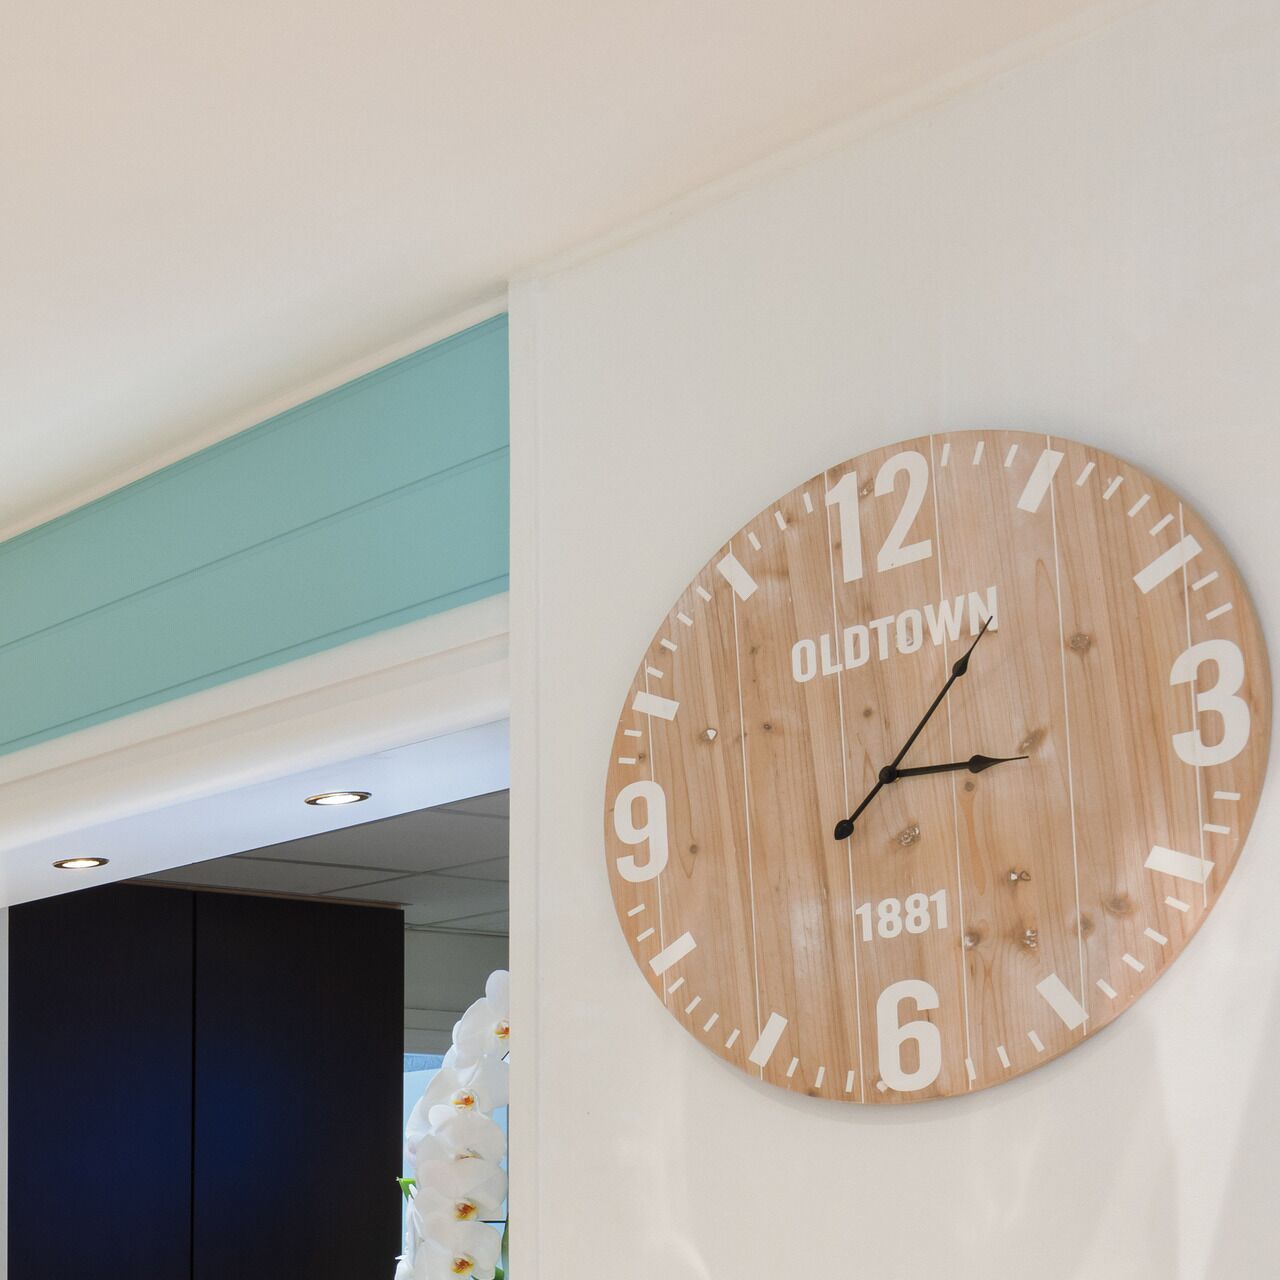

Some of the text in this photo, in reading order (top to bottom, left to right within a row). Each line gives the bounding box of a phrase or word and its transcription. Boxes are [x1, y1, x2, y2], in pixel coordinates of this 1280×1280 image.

[825, 451, 932, 583] 12
[791, 587, 999, 683] OLDTOWN
[1169, 640, 1251, 767] 3
[614, 781, 668, 883] 9
[854, 889, 948, 942] 1881
[876, 979, 942, 1092] 6
